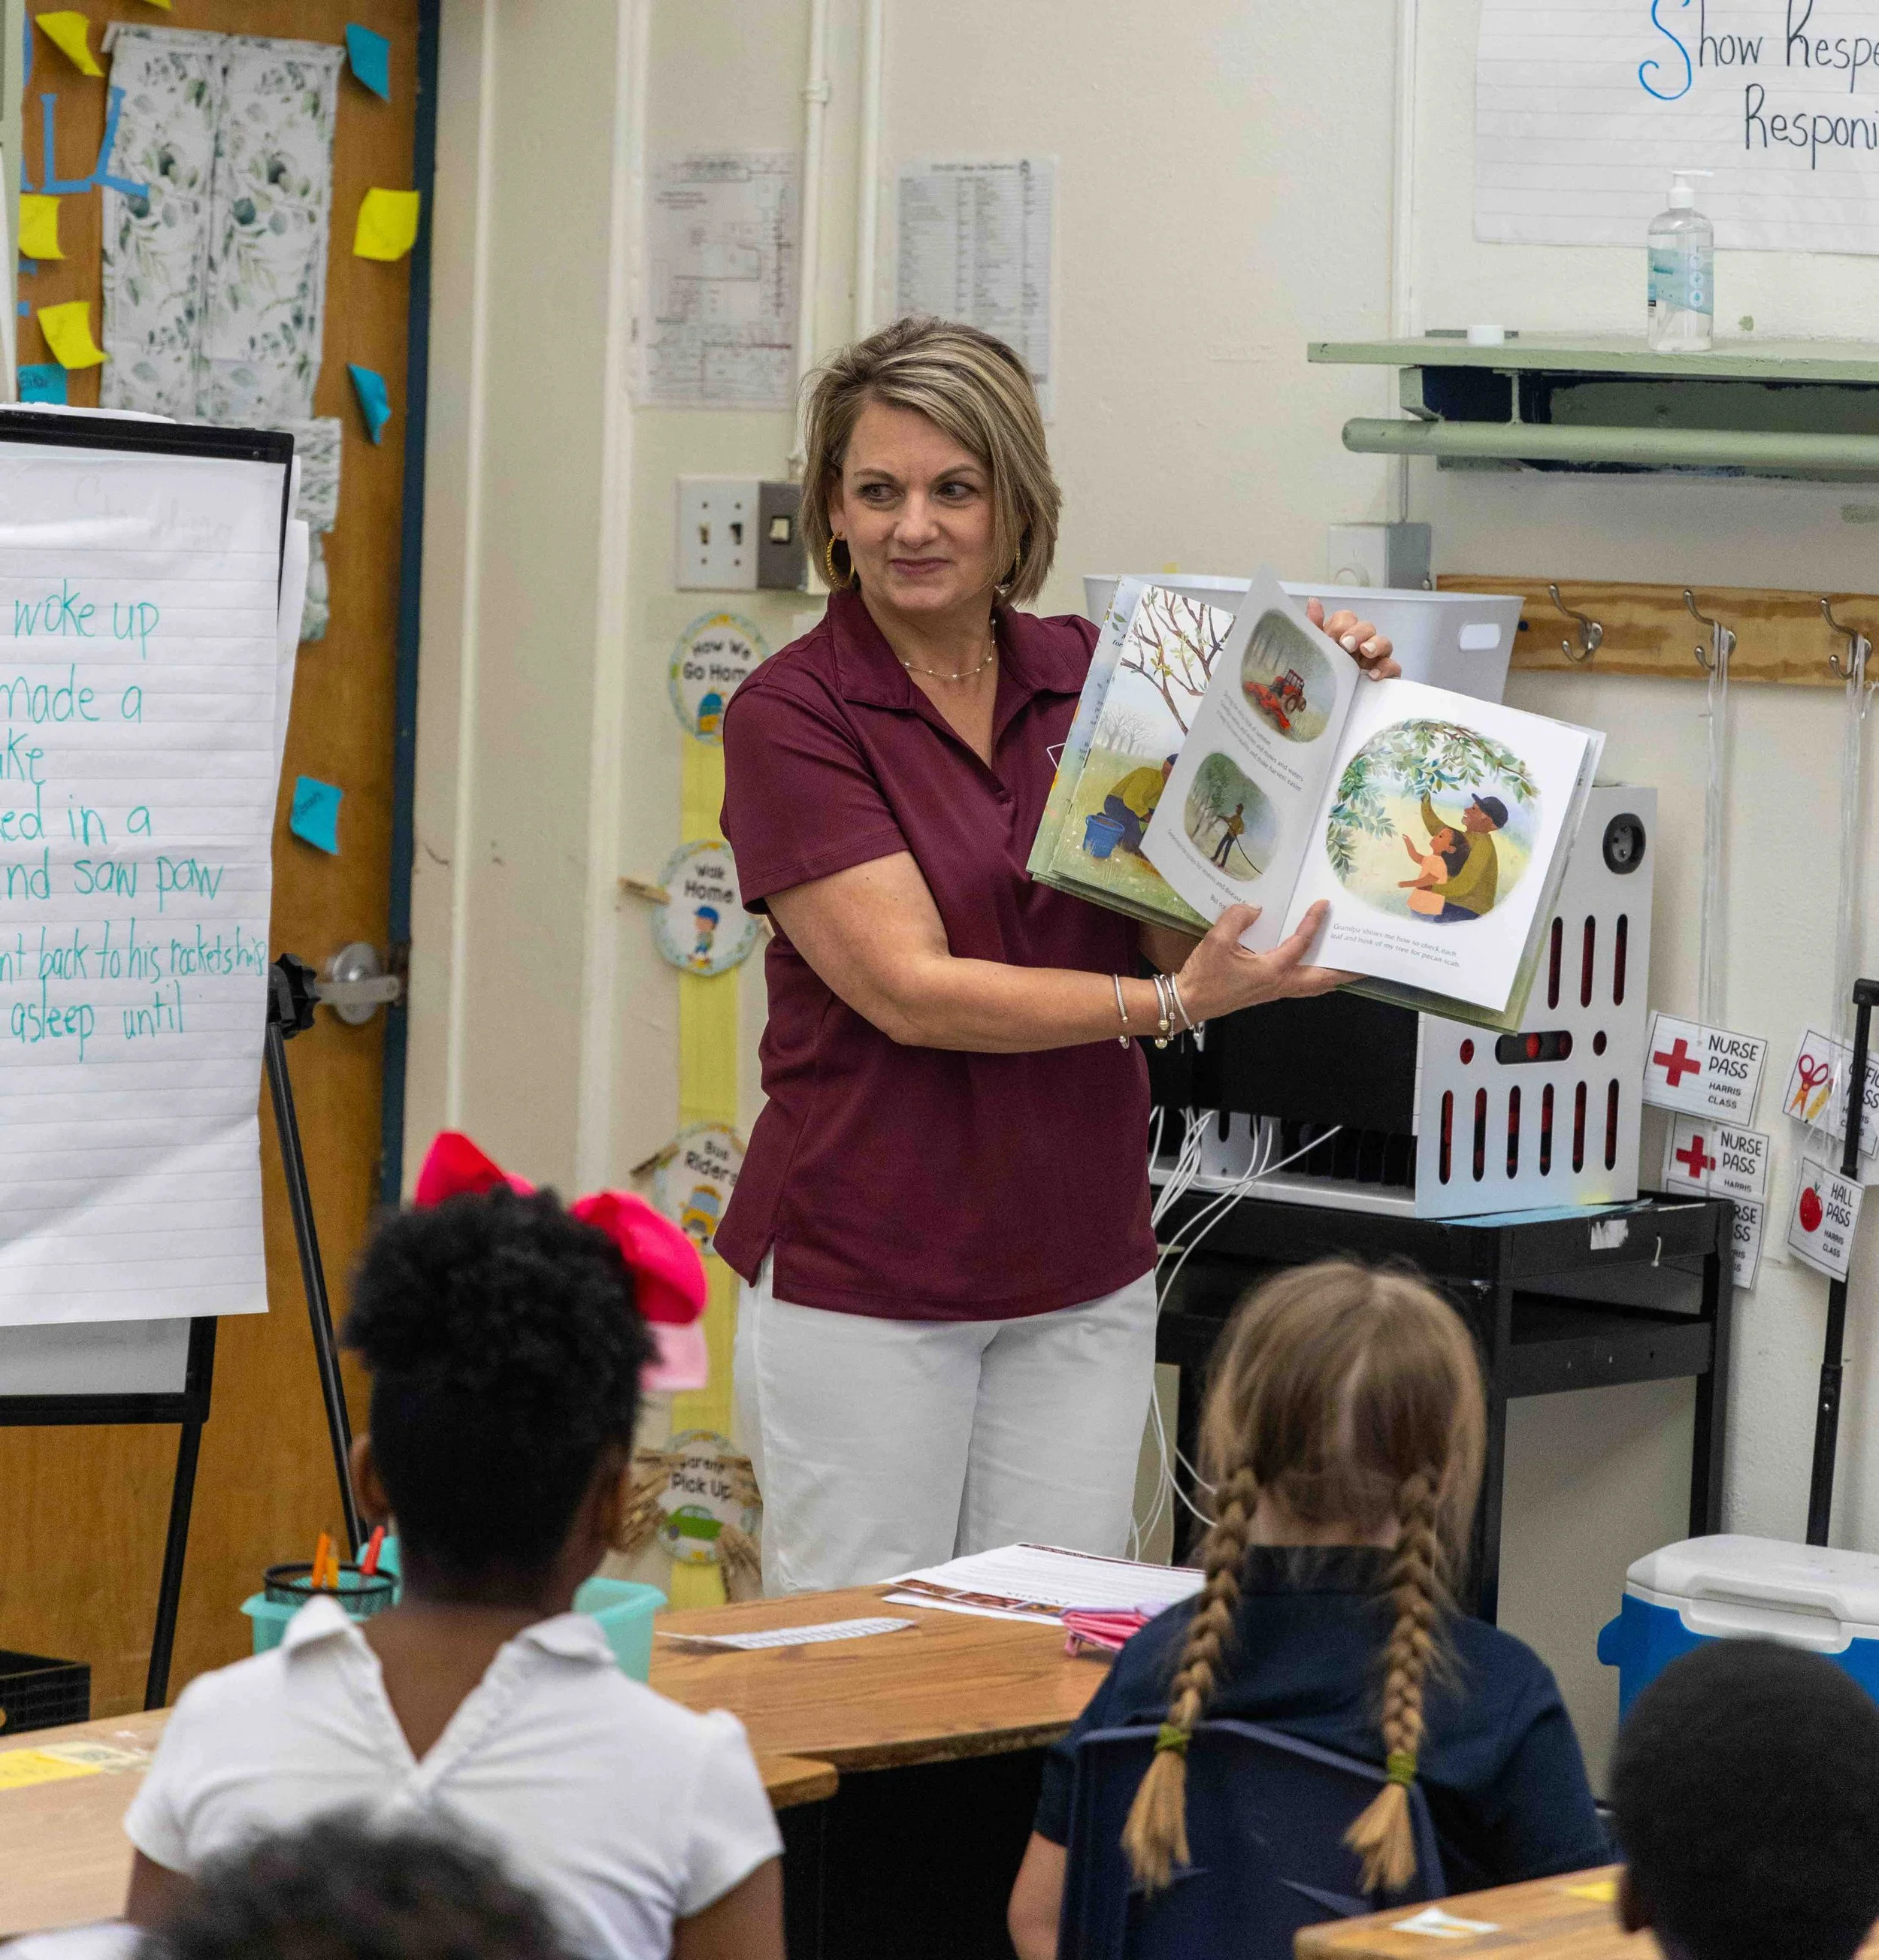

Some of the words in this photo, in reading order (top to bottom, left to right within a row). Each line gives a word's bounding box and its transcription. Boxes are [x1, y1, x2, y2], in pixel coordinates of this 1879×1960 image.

[1638, 0, 1763, 100] Show
[15, 578, 95, 638] woke
[113, 601, 159, 659] up
[692, 641, 725, 658] How
[729, 640, 751, 661] We
[682, 661, 705, 680] Go
[710, 664, 749, 682] Hom
[0, 663, 100, 724] made
[121, 685, 143, 723] a
[0, 727, 46, 785] ke
[68, 794, 107, 846] in
[127, 806, 151, 836] a
[74, 859, 137, 898] saw
[156, 856, 223, 912] paw
[695, 864, 725, 881] Walk
[685, 879, 734, 904] Home
[38, 925, 89, 979] back
[95, 920, 121, 979] to
[129, 917, 162, 984] his
[1330, 932, 1343, 941] leaf
[1344, 934, 1357, 942] and
[1384, 942, 1394, 951] my
[1396, 945, 1409, 954] tree
[1410, 948, 1421, 957] for
[1421, 951, 1442, 963] pecan
[1333, 923, 1361, 934] Grandpa
[1363, 928, 1383, 938] shows
[1384, 933, 1395, 941] me
[1396, 934, 1411, 945] how
[1421, 941, 1440, 953] check
[1441, 947, 1457, 957] each
[11, 975, 95, 1063] asleep
[123, 979, 183, 1039] until
[1708, 1034, 1759, 1062] NURSE
[1708, 1056, 1749, 1079] PASS
[1708, 1081, 1741, 1096] HARRIS
[1708, 1095, 1737, 1109] CLASS
[1721, 1131, 1763, 1157] NURSE
[1723, 1152, 1755, 1175] PASS
[1724, 1178, 1752, 1193] HARRIS
[1831, 1183, 1852, 1208] HALL
[1734, 1205, 1757, 1224] RSE
[1826, 1202, 1851, 1227] PASS
[1734, 1223, 1750, 1242] SS
[1824, 1229, 1844, 1245] HARRIS
[1823, 1243, 1841, 1258] CLASS
[671, 1472, 706, 1494] Pick
